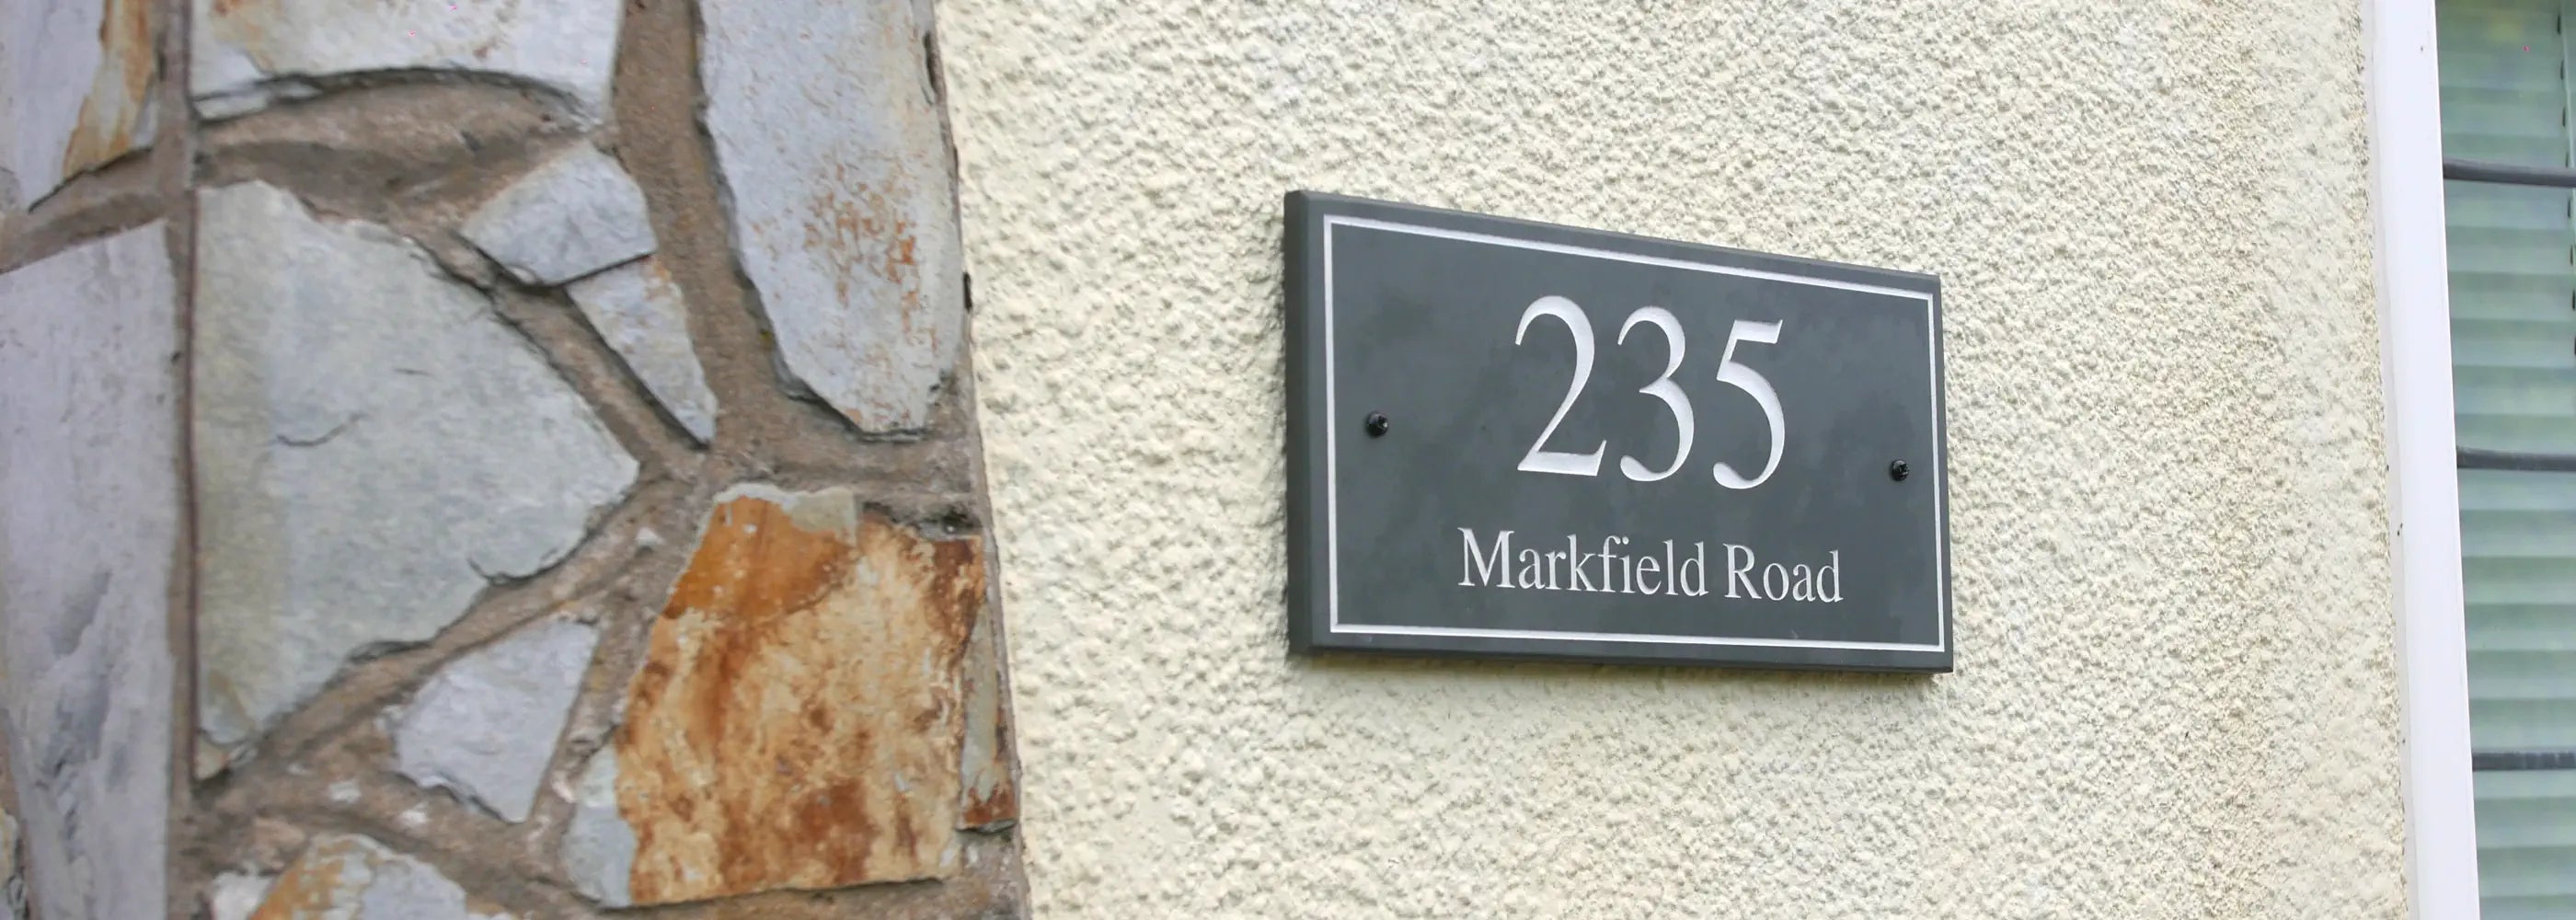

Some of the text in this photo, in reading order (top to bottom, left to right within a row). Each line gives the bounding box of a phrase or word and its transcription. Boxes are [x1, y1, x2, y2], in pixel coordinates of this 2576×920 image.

[1514, 294, 1787, 489] 235
[1456, 526, 1844, 604] Markfield Road
